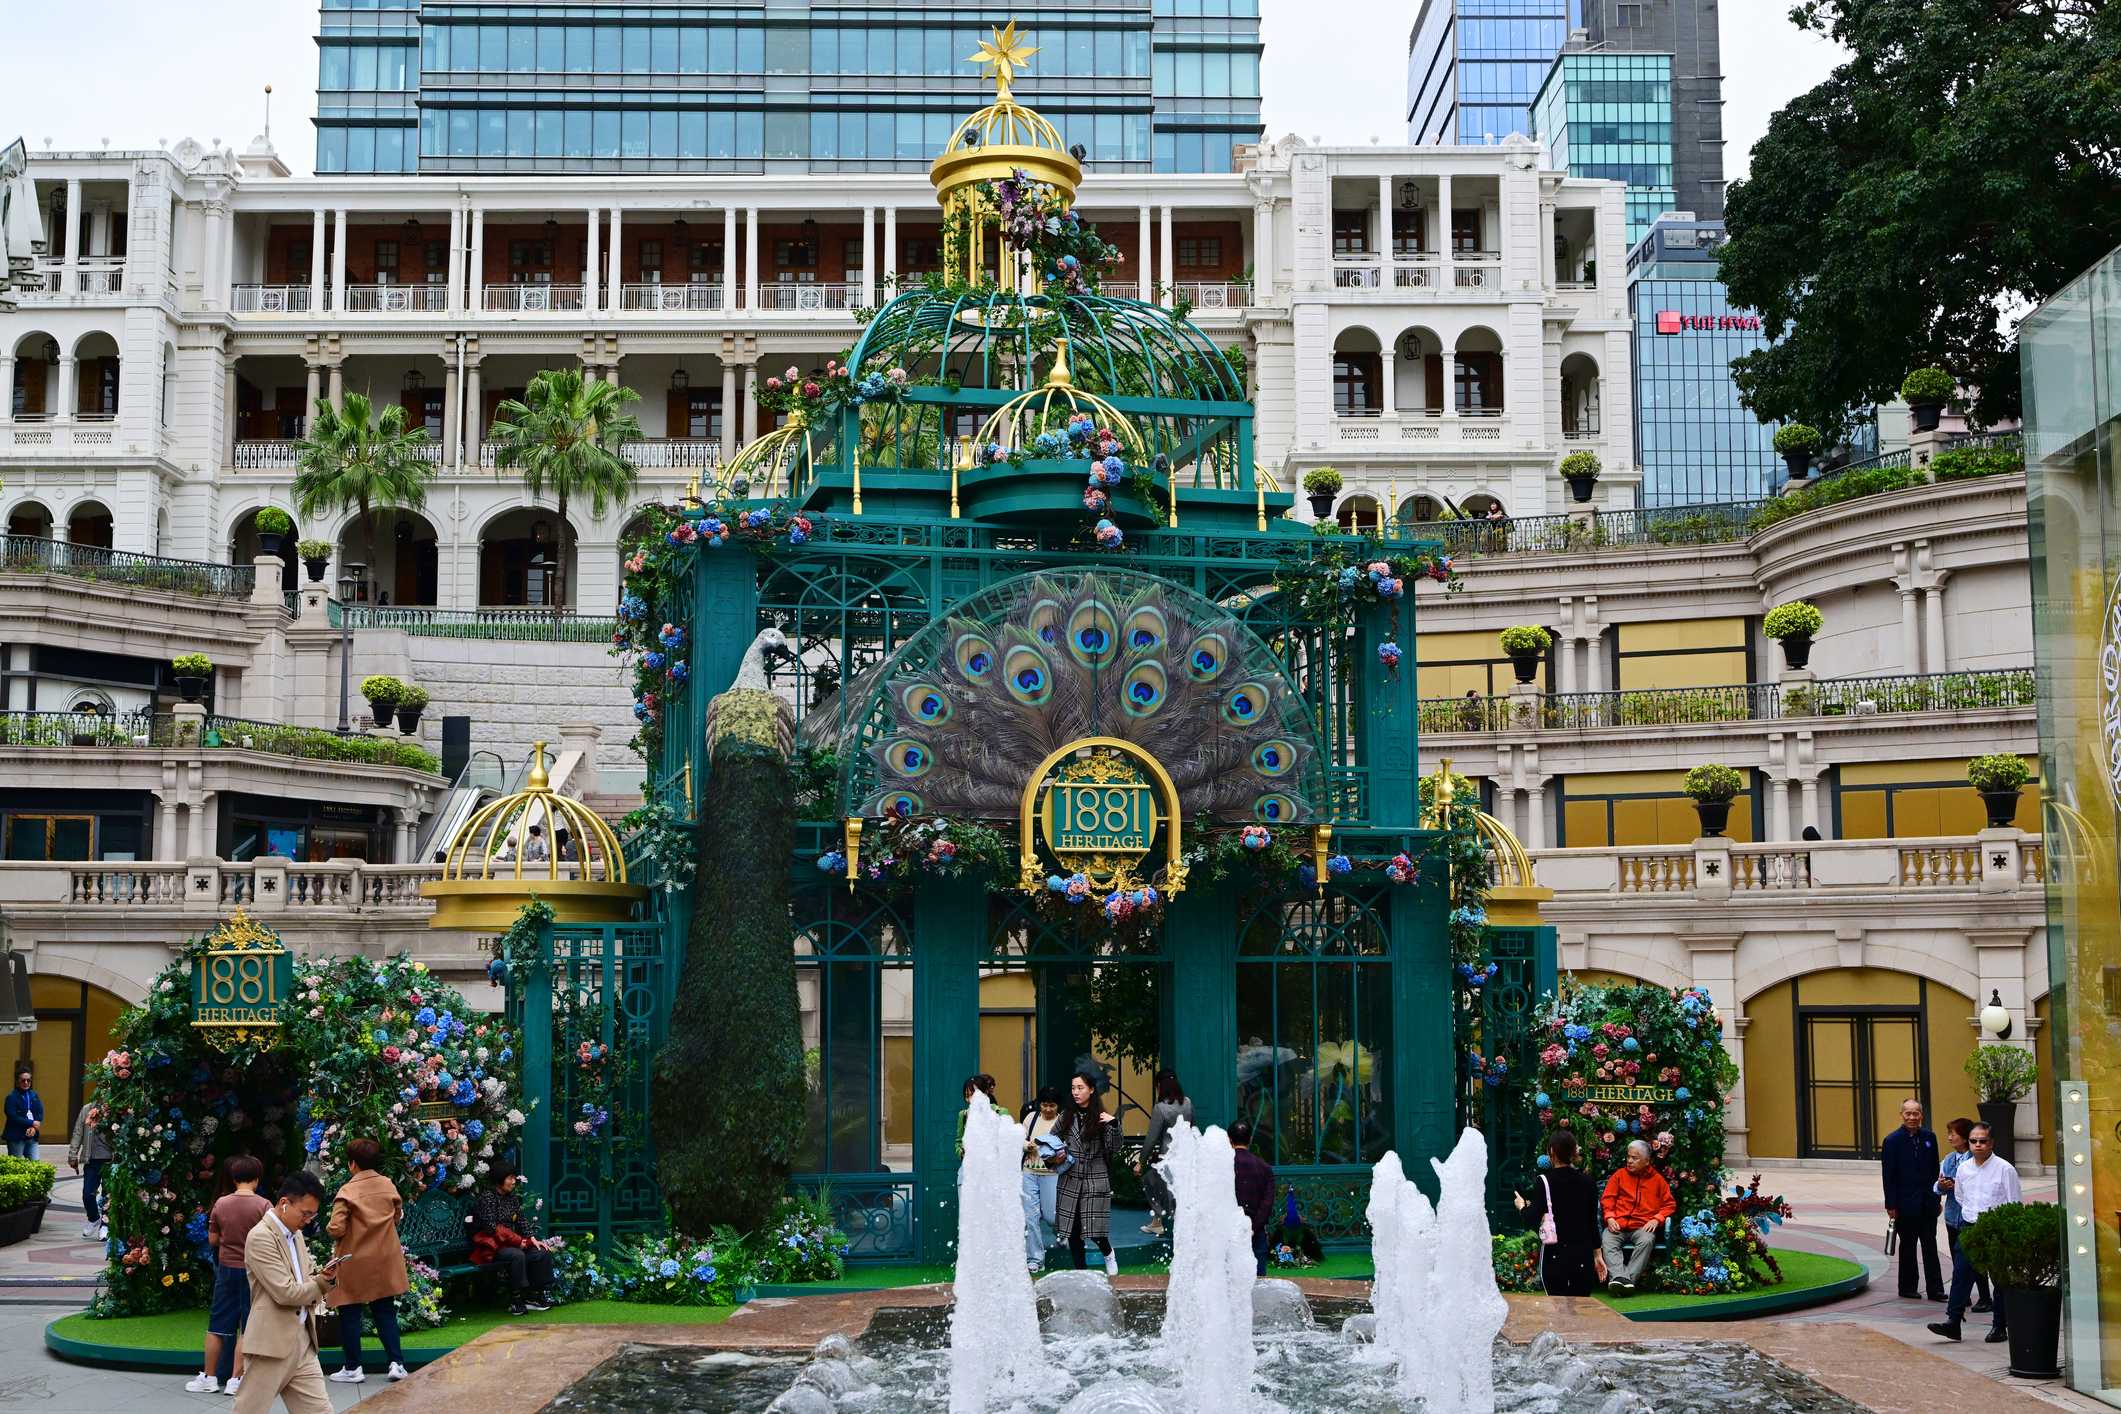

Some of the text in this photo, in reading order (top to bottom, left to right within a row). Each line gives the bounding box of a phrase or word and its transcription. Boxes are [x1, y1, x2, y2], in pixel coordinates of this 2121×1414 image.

[1680, 316, 1761, 330] YUE HWA
[1061, 787, 1142, 832] 1881
[1061, 834, 1143, 848] HERITAGE
[198, 954, 278, 1004] 1881
[197, 1007, 278, 1023] HERITAGE
[1567, 1087, 1675, 1102] 1881 HERITAGE
